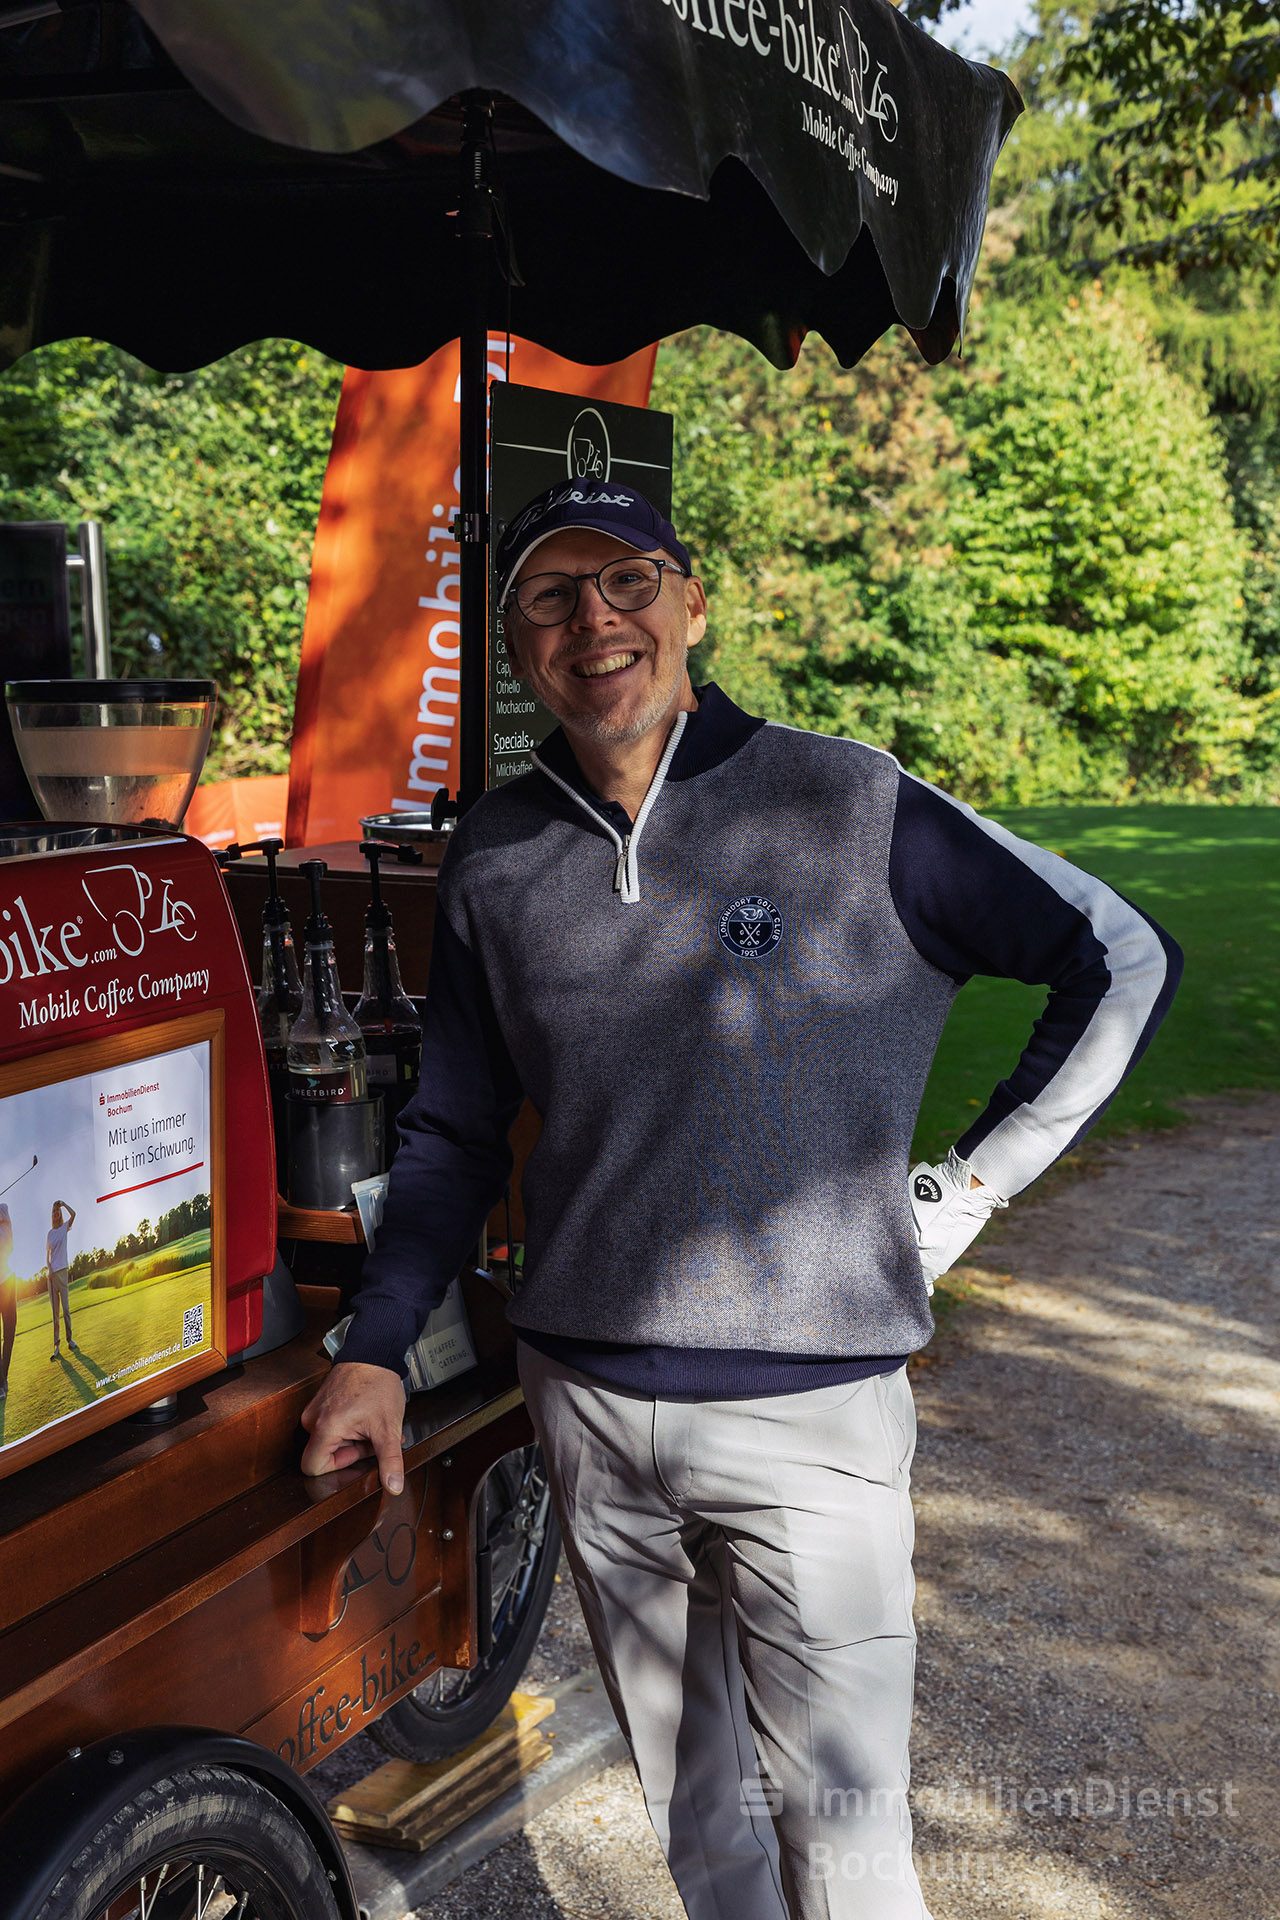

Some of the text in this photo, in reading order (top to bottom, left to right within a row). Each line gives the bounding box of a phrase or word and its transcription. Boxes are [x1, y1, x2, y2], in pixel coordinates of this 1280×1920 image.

[801, 101, 899, 206] Mobile Coffee Company
[496, 680, 521, 695] Othello
[496, 699, 536, 715] Mochaccino
[493, 730, 530, 753] Specials
[496, 760, 533, 777] Milchkaffee
[720, 897, 781, 941] LONGNIDDRY GOLF CLUB
[91, 947, 118, 964] .com
[740, 949, 758, 957] 1921
[18, 968, 210, 1030] Mobile Coffee Company
[106, 1082, 160, 1103] ImmobilienDienst
[107, 1103, 133, 1117] Bochum
[108, 1112, 187, 1147] Mit uns immer
[109, 1136, 196, 1180] gut im Schwung.
[95, 1342, 181, 1389] www.s-immobiliendienst.de
